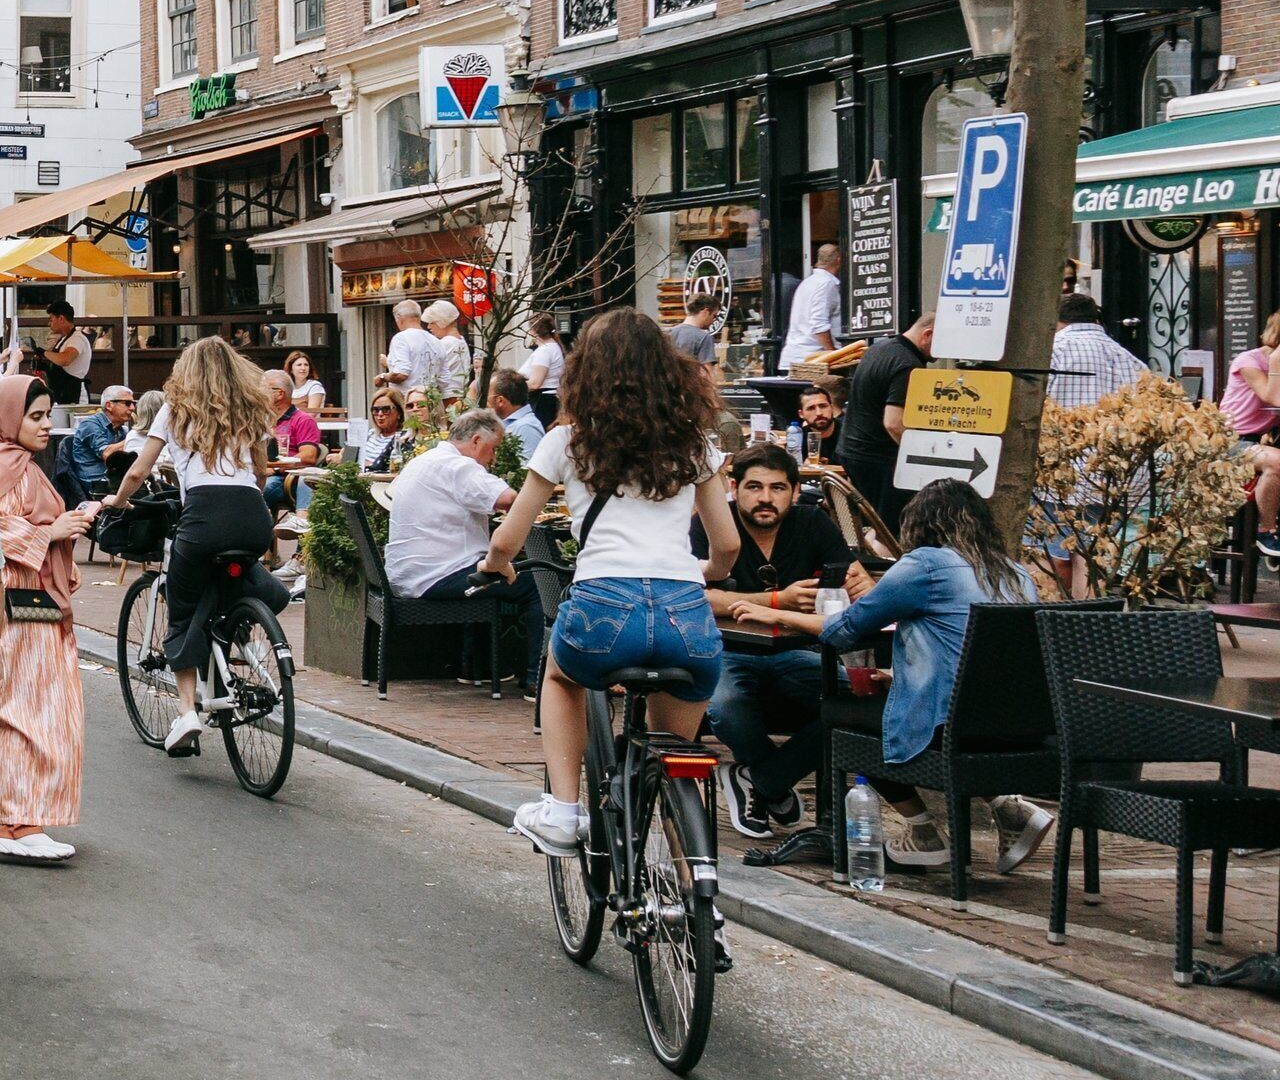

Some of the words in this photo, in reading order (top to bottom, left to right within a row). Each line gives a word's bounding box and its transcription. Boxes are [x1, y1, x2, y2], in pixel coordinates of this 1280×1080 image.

[967, 135, 1008, 221] P
[852, 194, 875, 211] WIJN
[1073, 184, 1121, 212] Café
[1123, 184, 1189, 212] Lange
[1192, 178, 1235, 203] Leo
[852, 236, 891, 253] COFFEE
[858, 263, 880, 275] KAAS
[863, 297, 892, 310] NOTEN
[917, 403, 992, 418] wegsleepregeling
[929, 418, 944, 427] van
